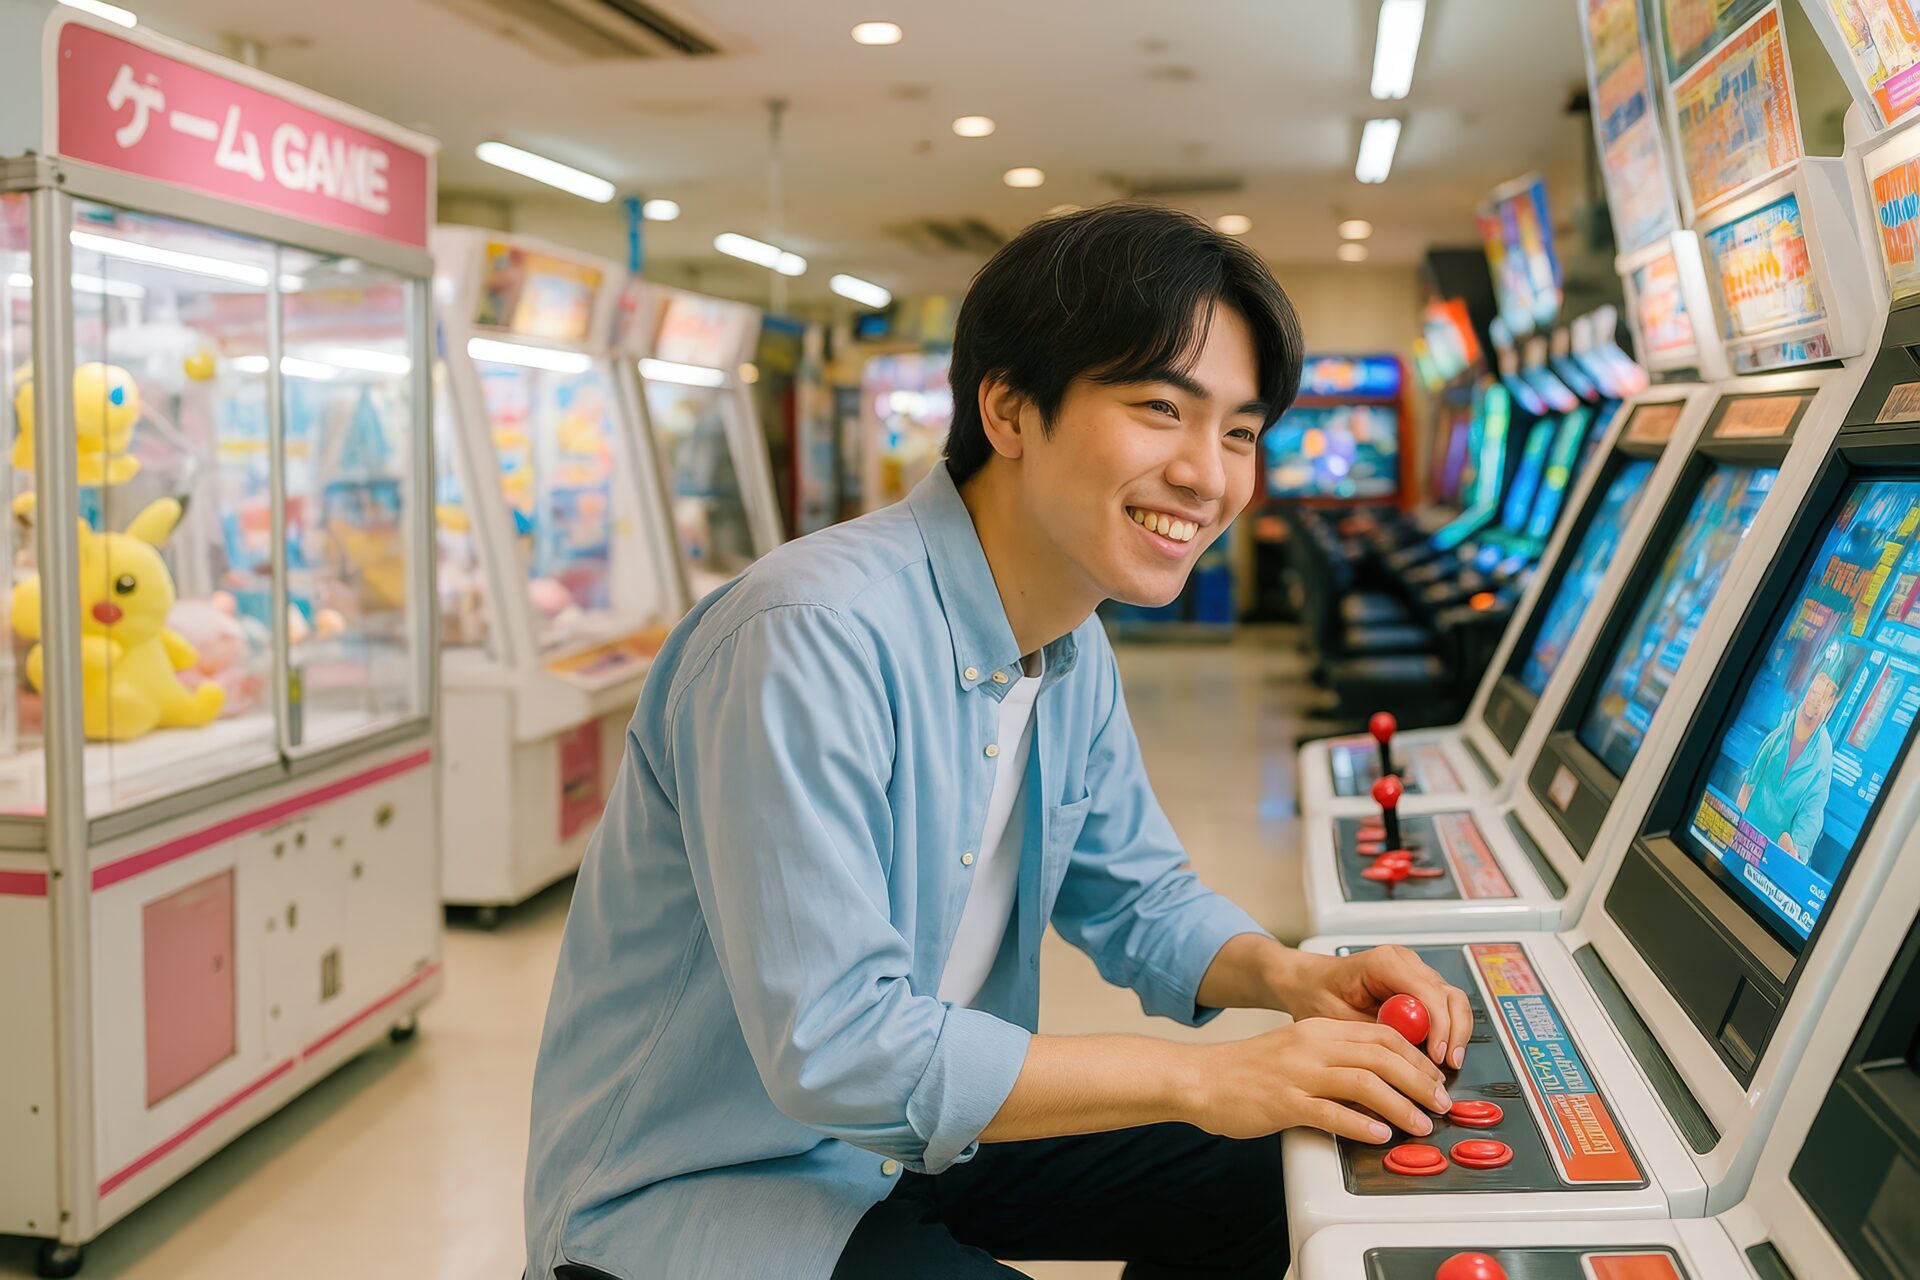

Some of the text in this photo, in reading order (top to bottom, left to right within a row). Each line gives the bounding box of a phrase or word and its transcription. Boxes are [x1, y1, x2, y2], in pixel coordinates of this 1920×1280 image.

[107, 64, 390, 215] ゲーム GAME
